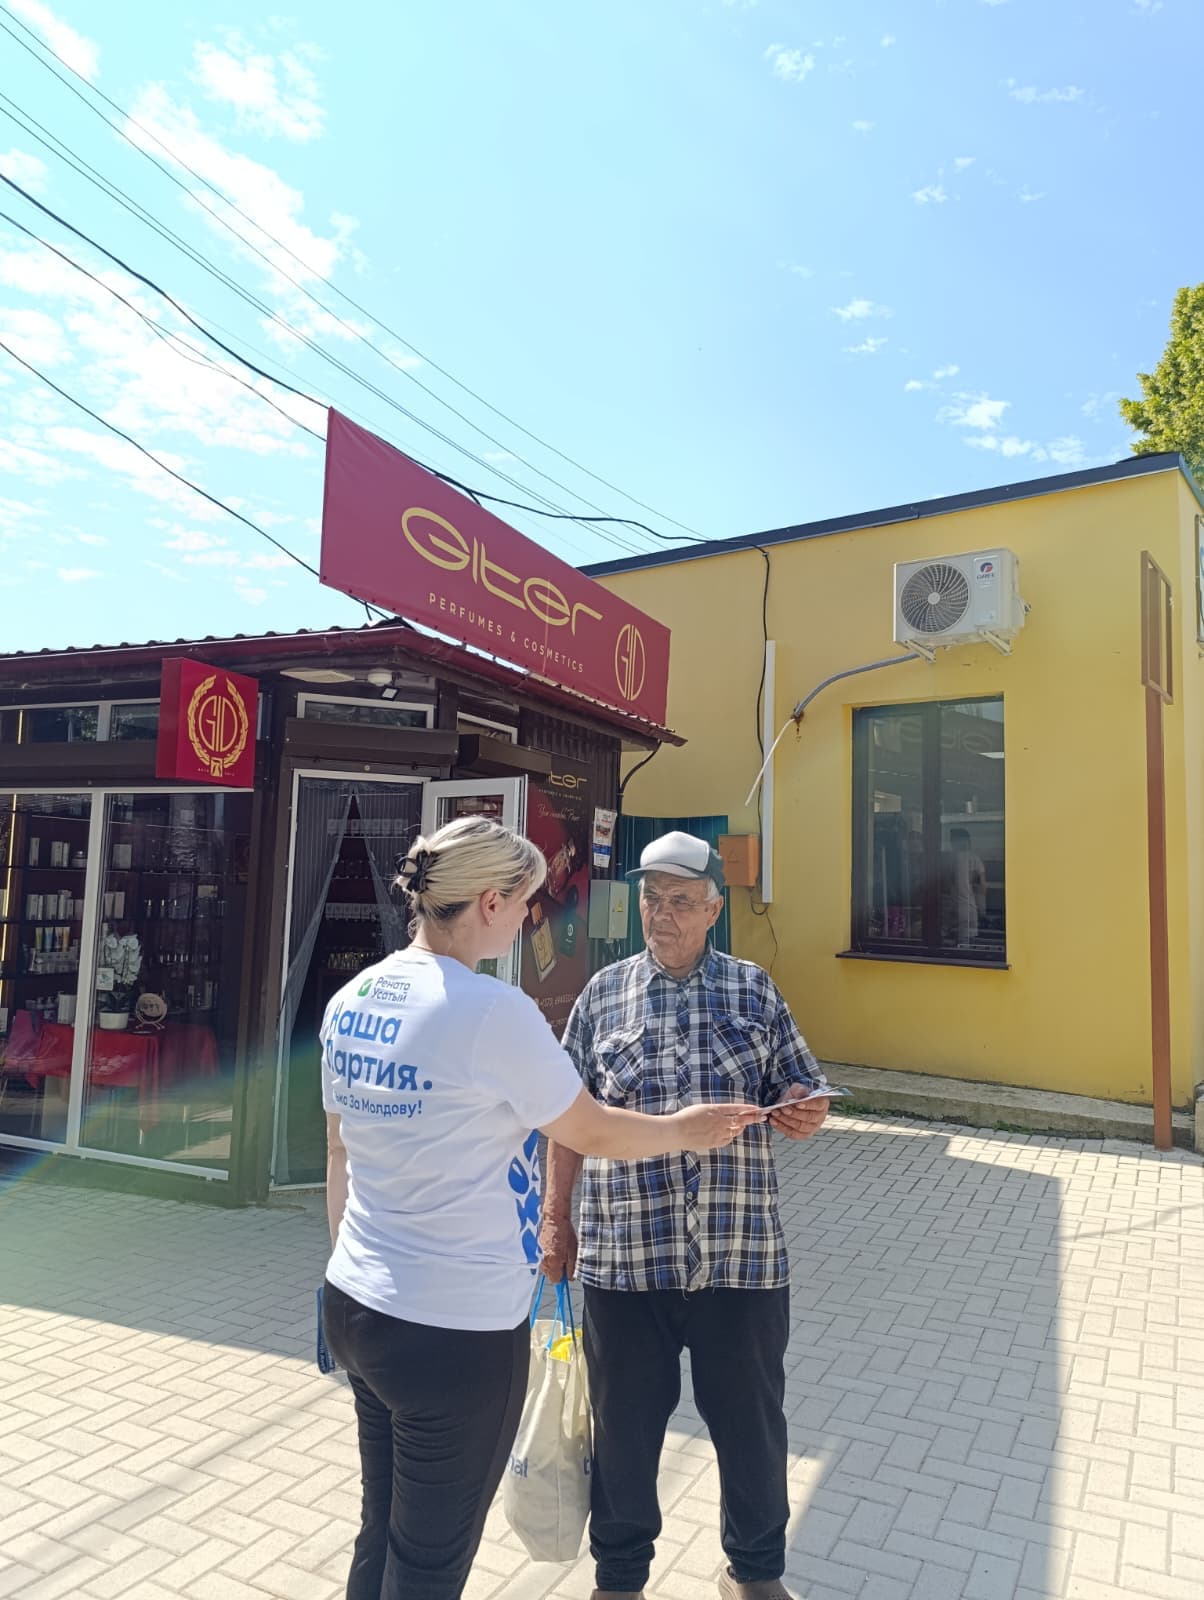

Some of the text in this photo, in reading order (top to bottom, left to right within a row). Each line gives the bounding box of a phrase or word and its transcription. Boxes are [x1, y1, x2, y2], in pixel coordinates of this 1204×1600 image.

[429, 592, 584, 673] PERFUMES & COSMETICS
[376, 977, 411, 991] Рената
[371, 987, 408, 1003] Усатый
[349, 1095, 360, 1110] За
[361, 1099, 423, 1118] Молдову!
